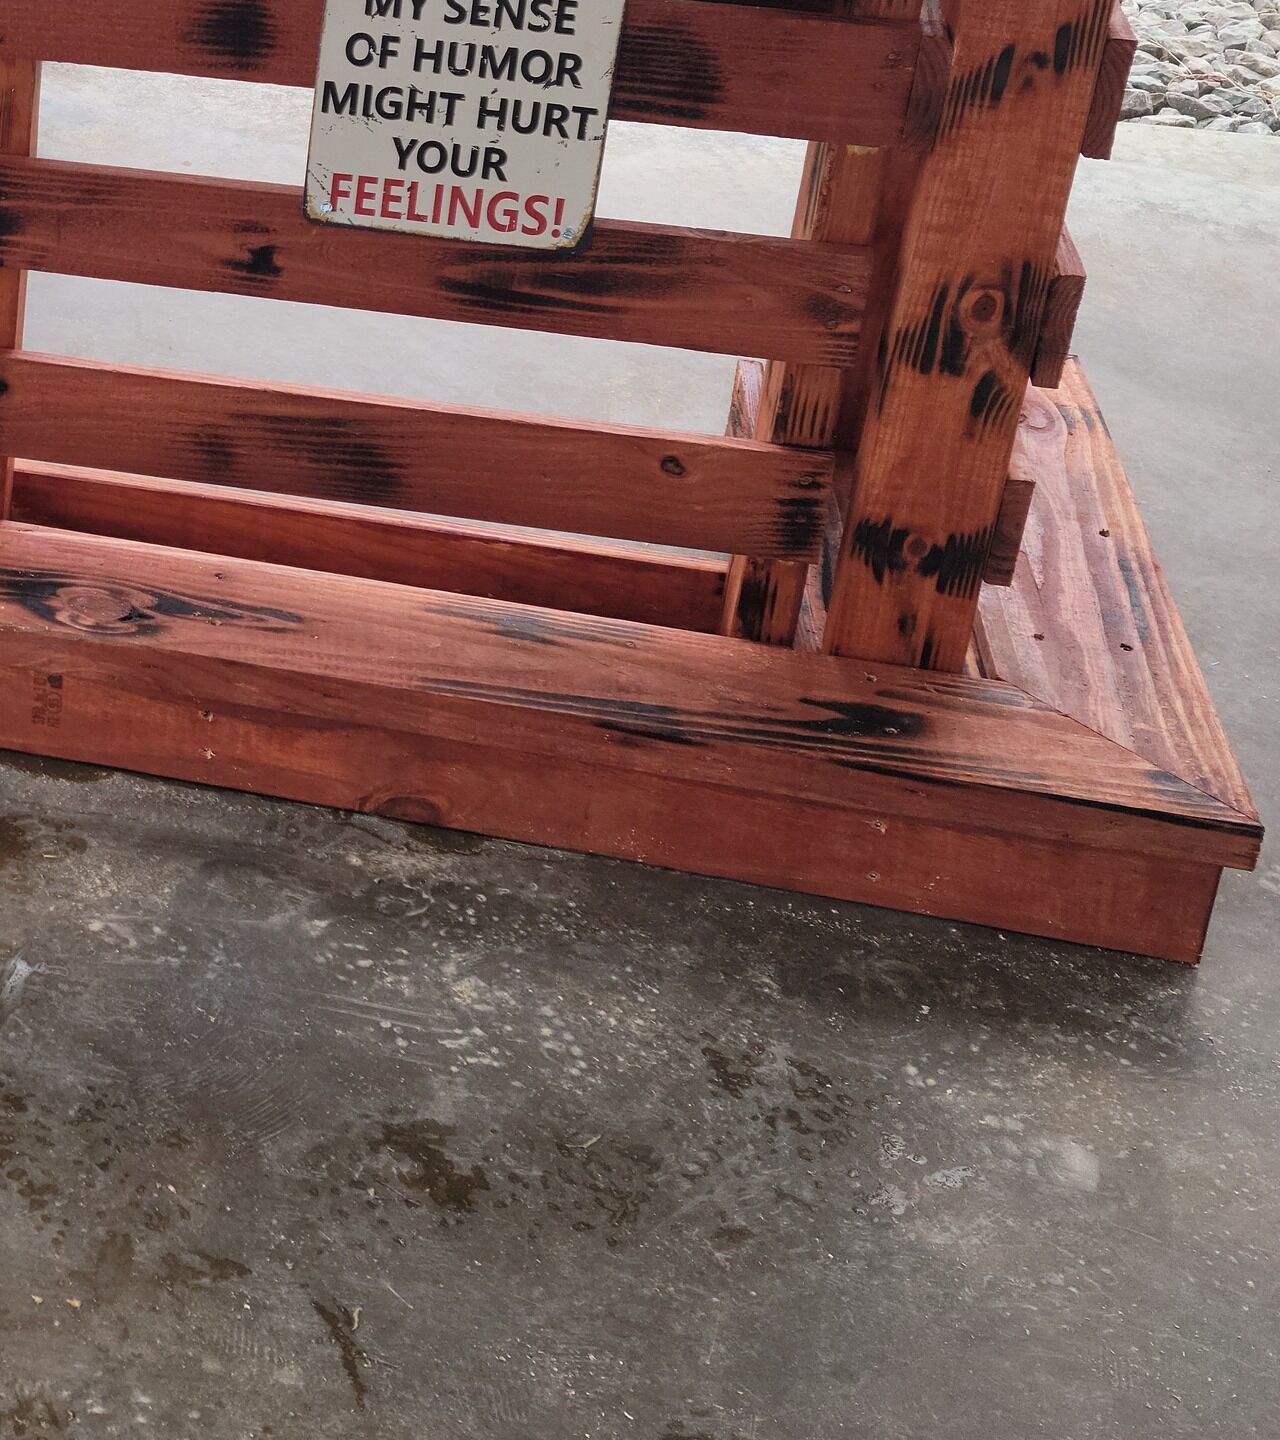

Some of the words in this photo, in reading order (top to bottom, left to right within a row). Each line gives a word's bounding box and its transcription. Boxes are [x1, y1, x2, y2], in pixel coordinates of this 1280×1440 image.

[345, 32, 401, 69] OF
[413, 38, 582, 88] HUMOR
[320, 80, 465, 127] MIGHT
[476, 96, 598, 141] HURT
[392, 137, 508, 182] YOUR
[330, 173, 565, 238] FEELINGS!
